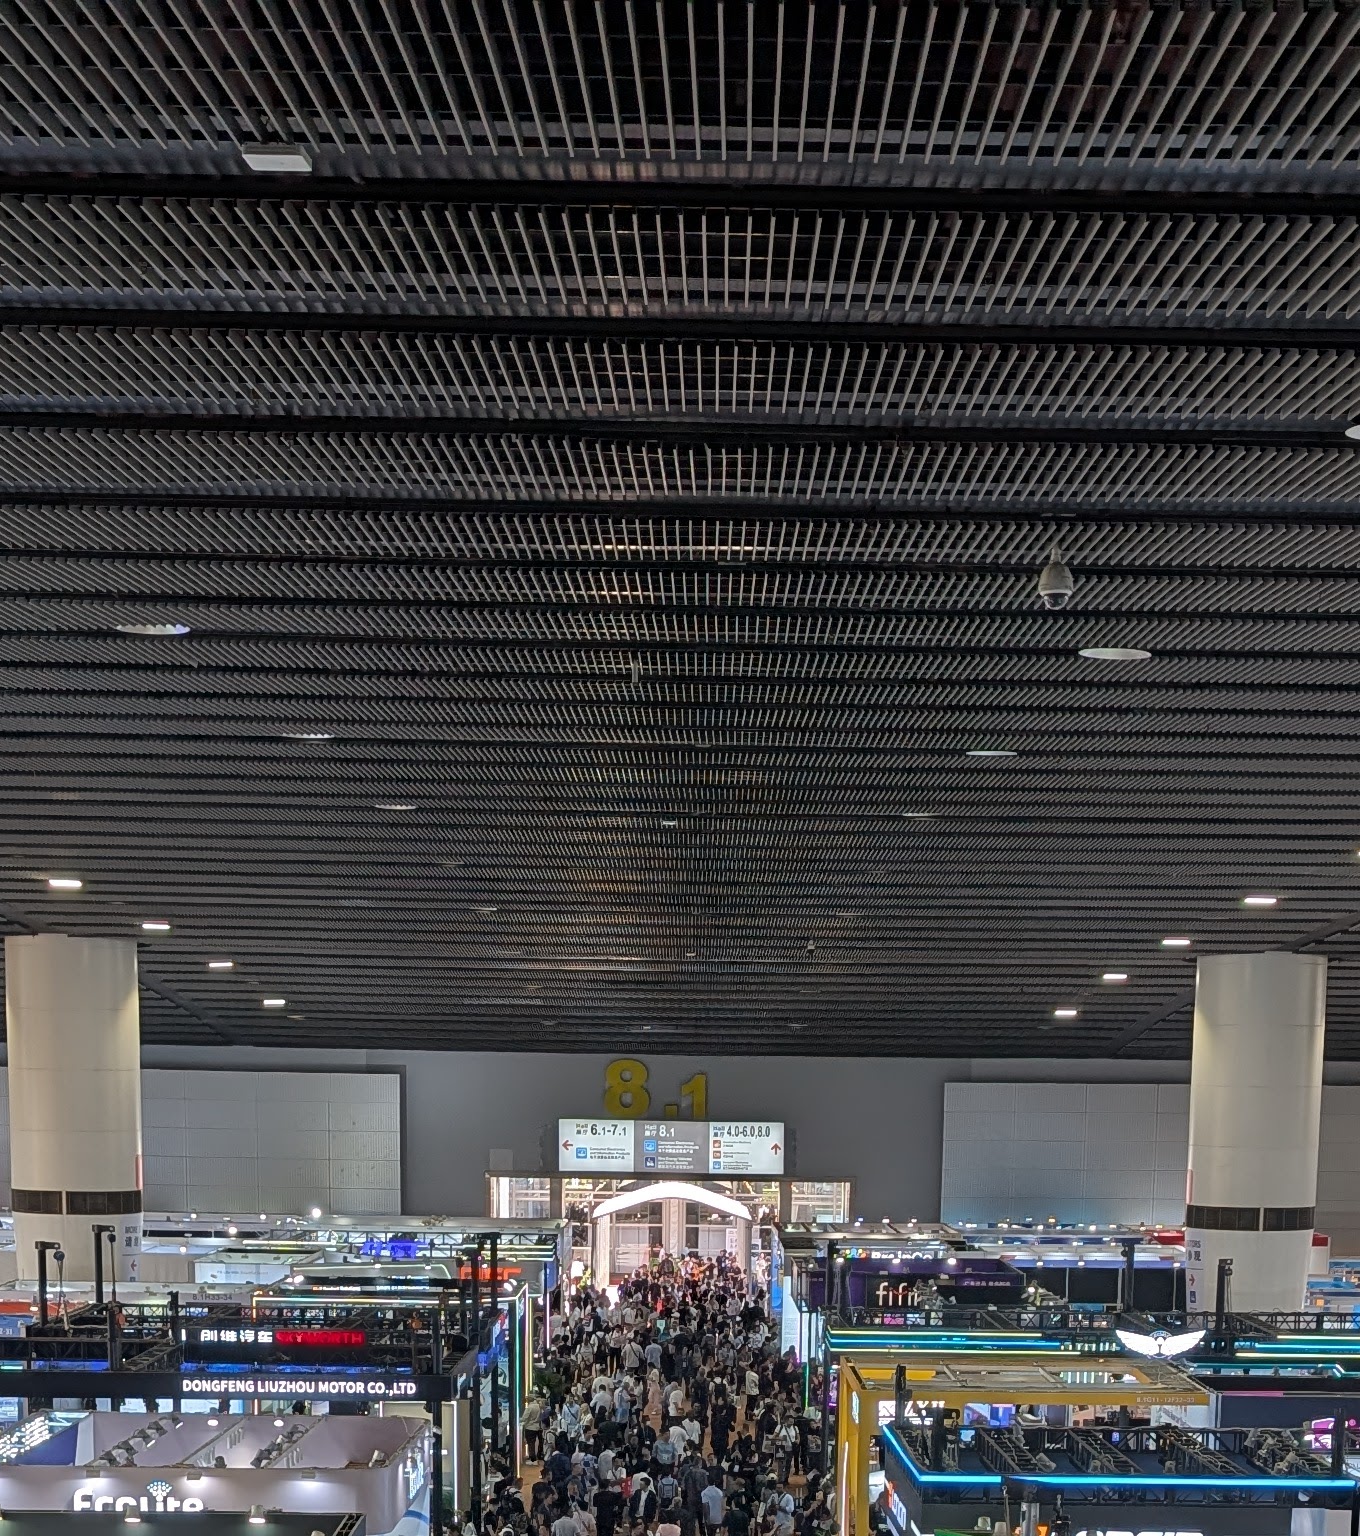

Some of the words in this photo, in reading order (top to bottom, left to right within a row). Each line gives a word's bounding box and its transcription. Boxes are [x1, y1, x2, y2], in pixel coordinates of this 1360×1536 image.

[604, 1058, 708, 1119] 8.1
[590, 1123, 627, 1136] 6.1-7.1
[659, 1125, 675, 1137] 8.1
[726, 1126, 770, 1138] 4.0-6.0,8.0
[275, 1331, 364, 1344] SKYWORTH
[182, 1378, 254, 1394] DONGFENG
[257, 1379, 315, 1395] LIUZHOU
[318, 1380, 365, 1396] MOTOR
